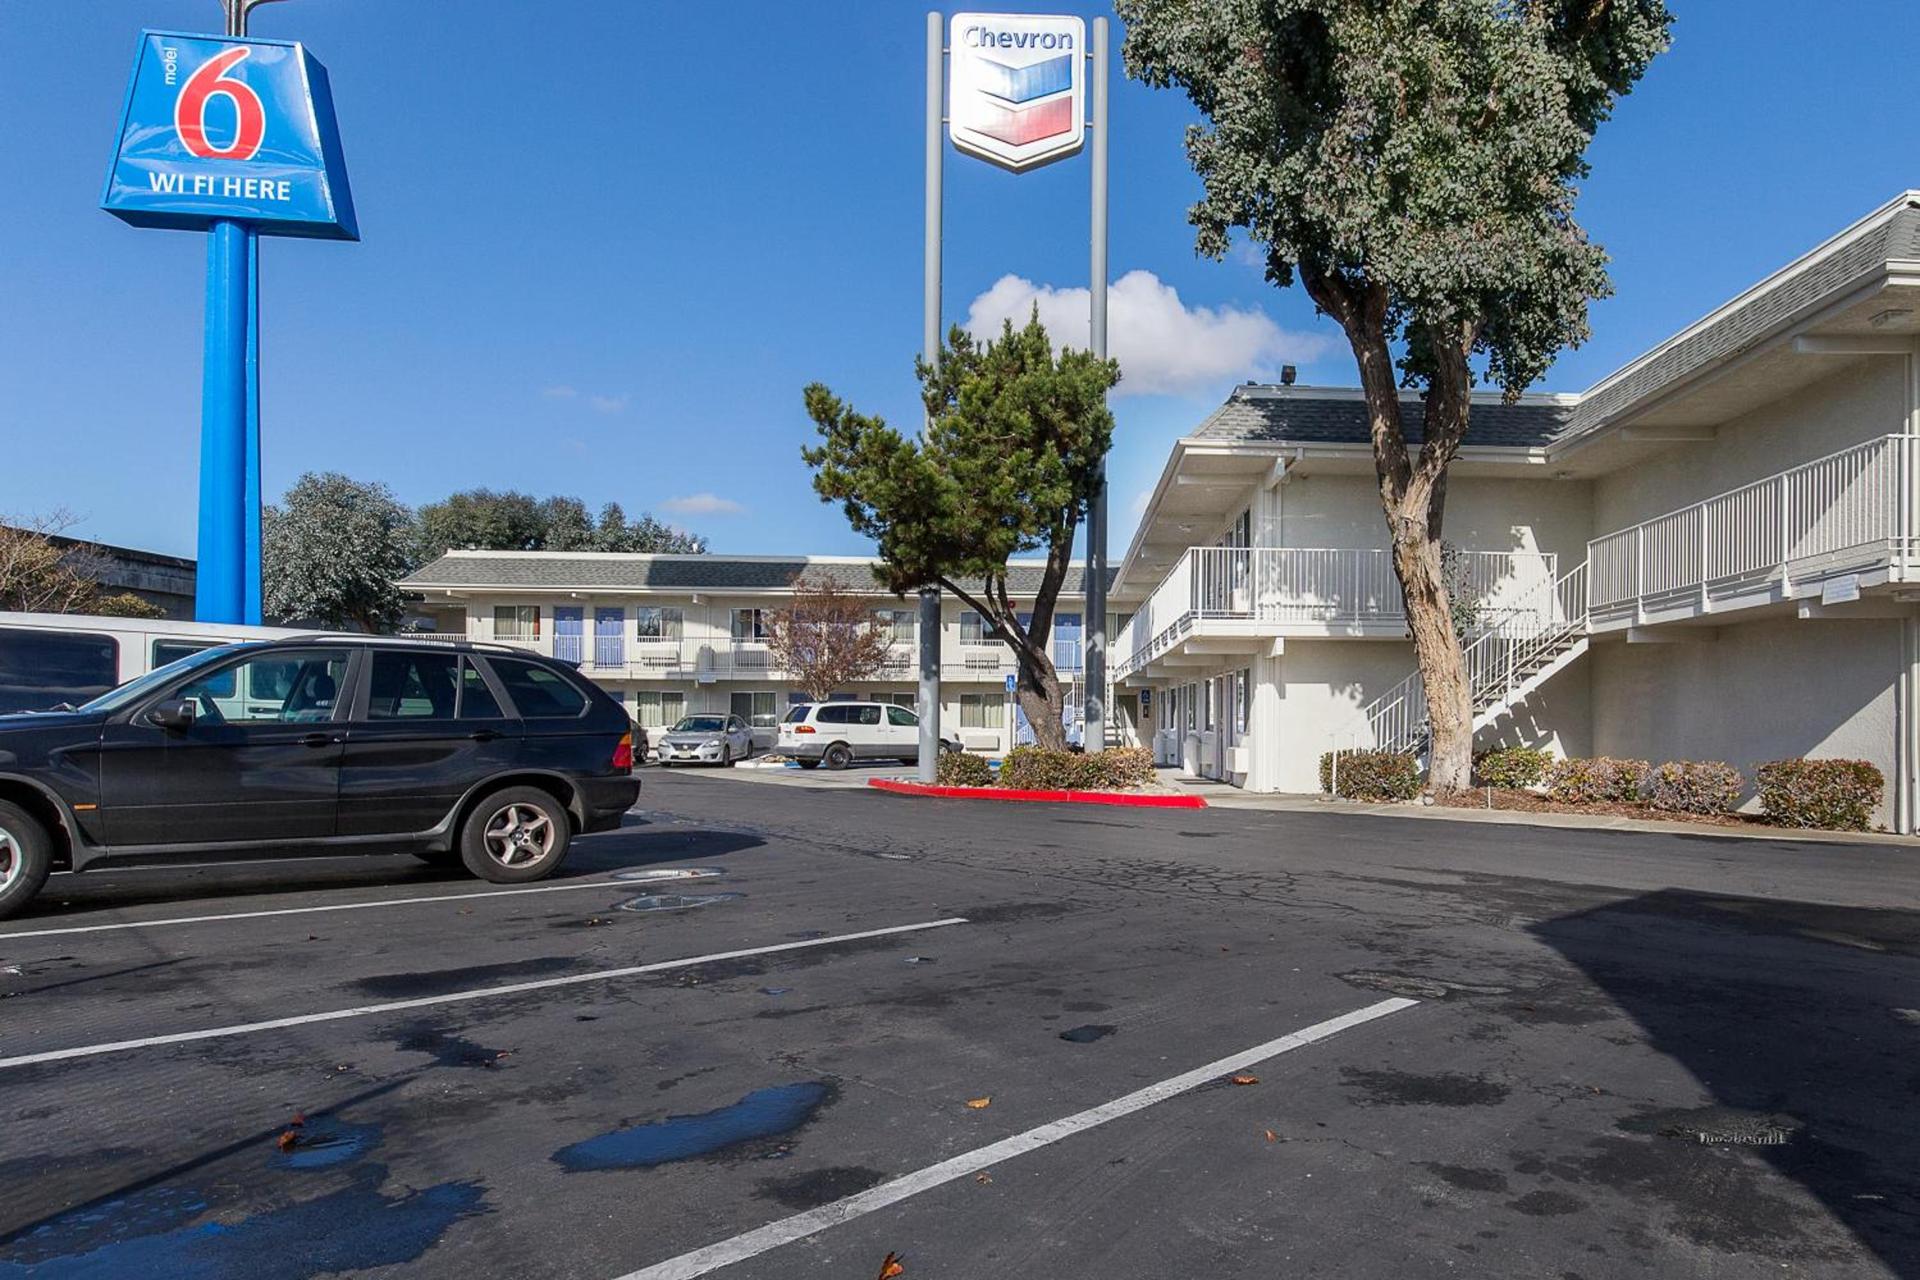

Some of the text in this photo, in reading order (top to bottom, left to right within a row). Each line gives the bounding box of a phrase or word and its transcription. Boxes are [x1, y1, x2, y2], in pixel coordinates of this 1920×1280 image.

[963, 26, 1073, 49] Chevron
[165, 45, 266, 161] motel 6
[149, 172, 291, 201] WI FI HERE
